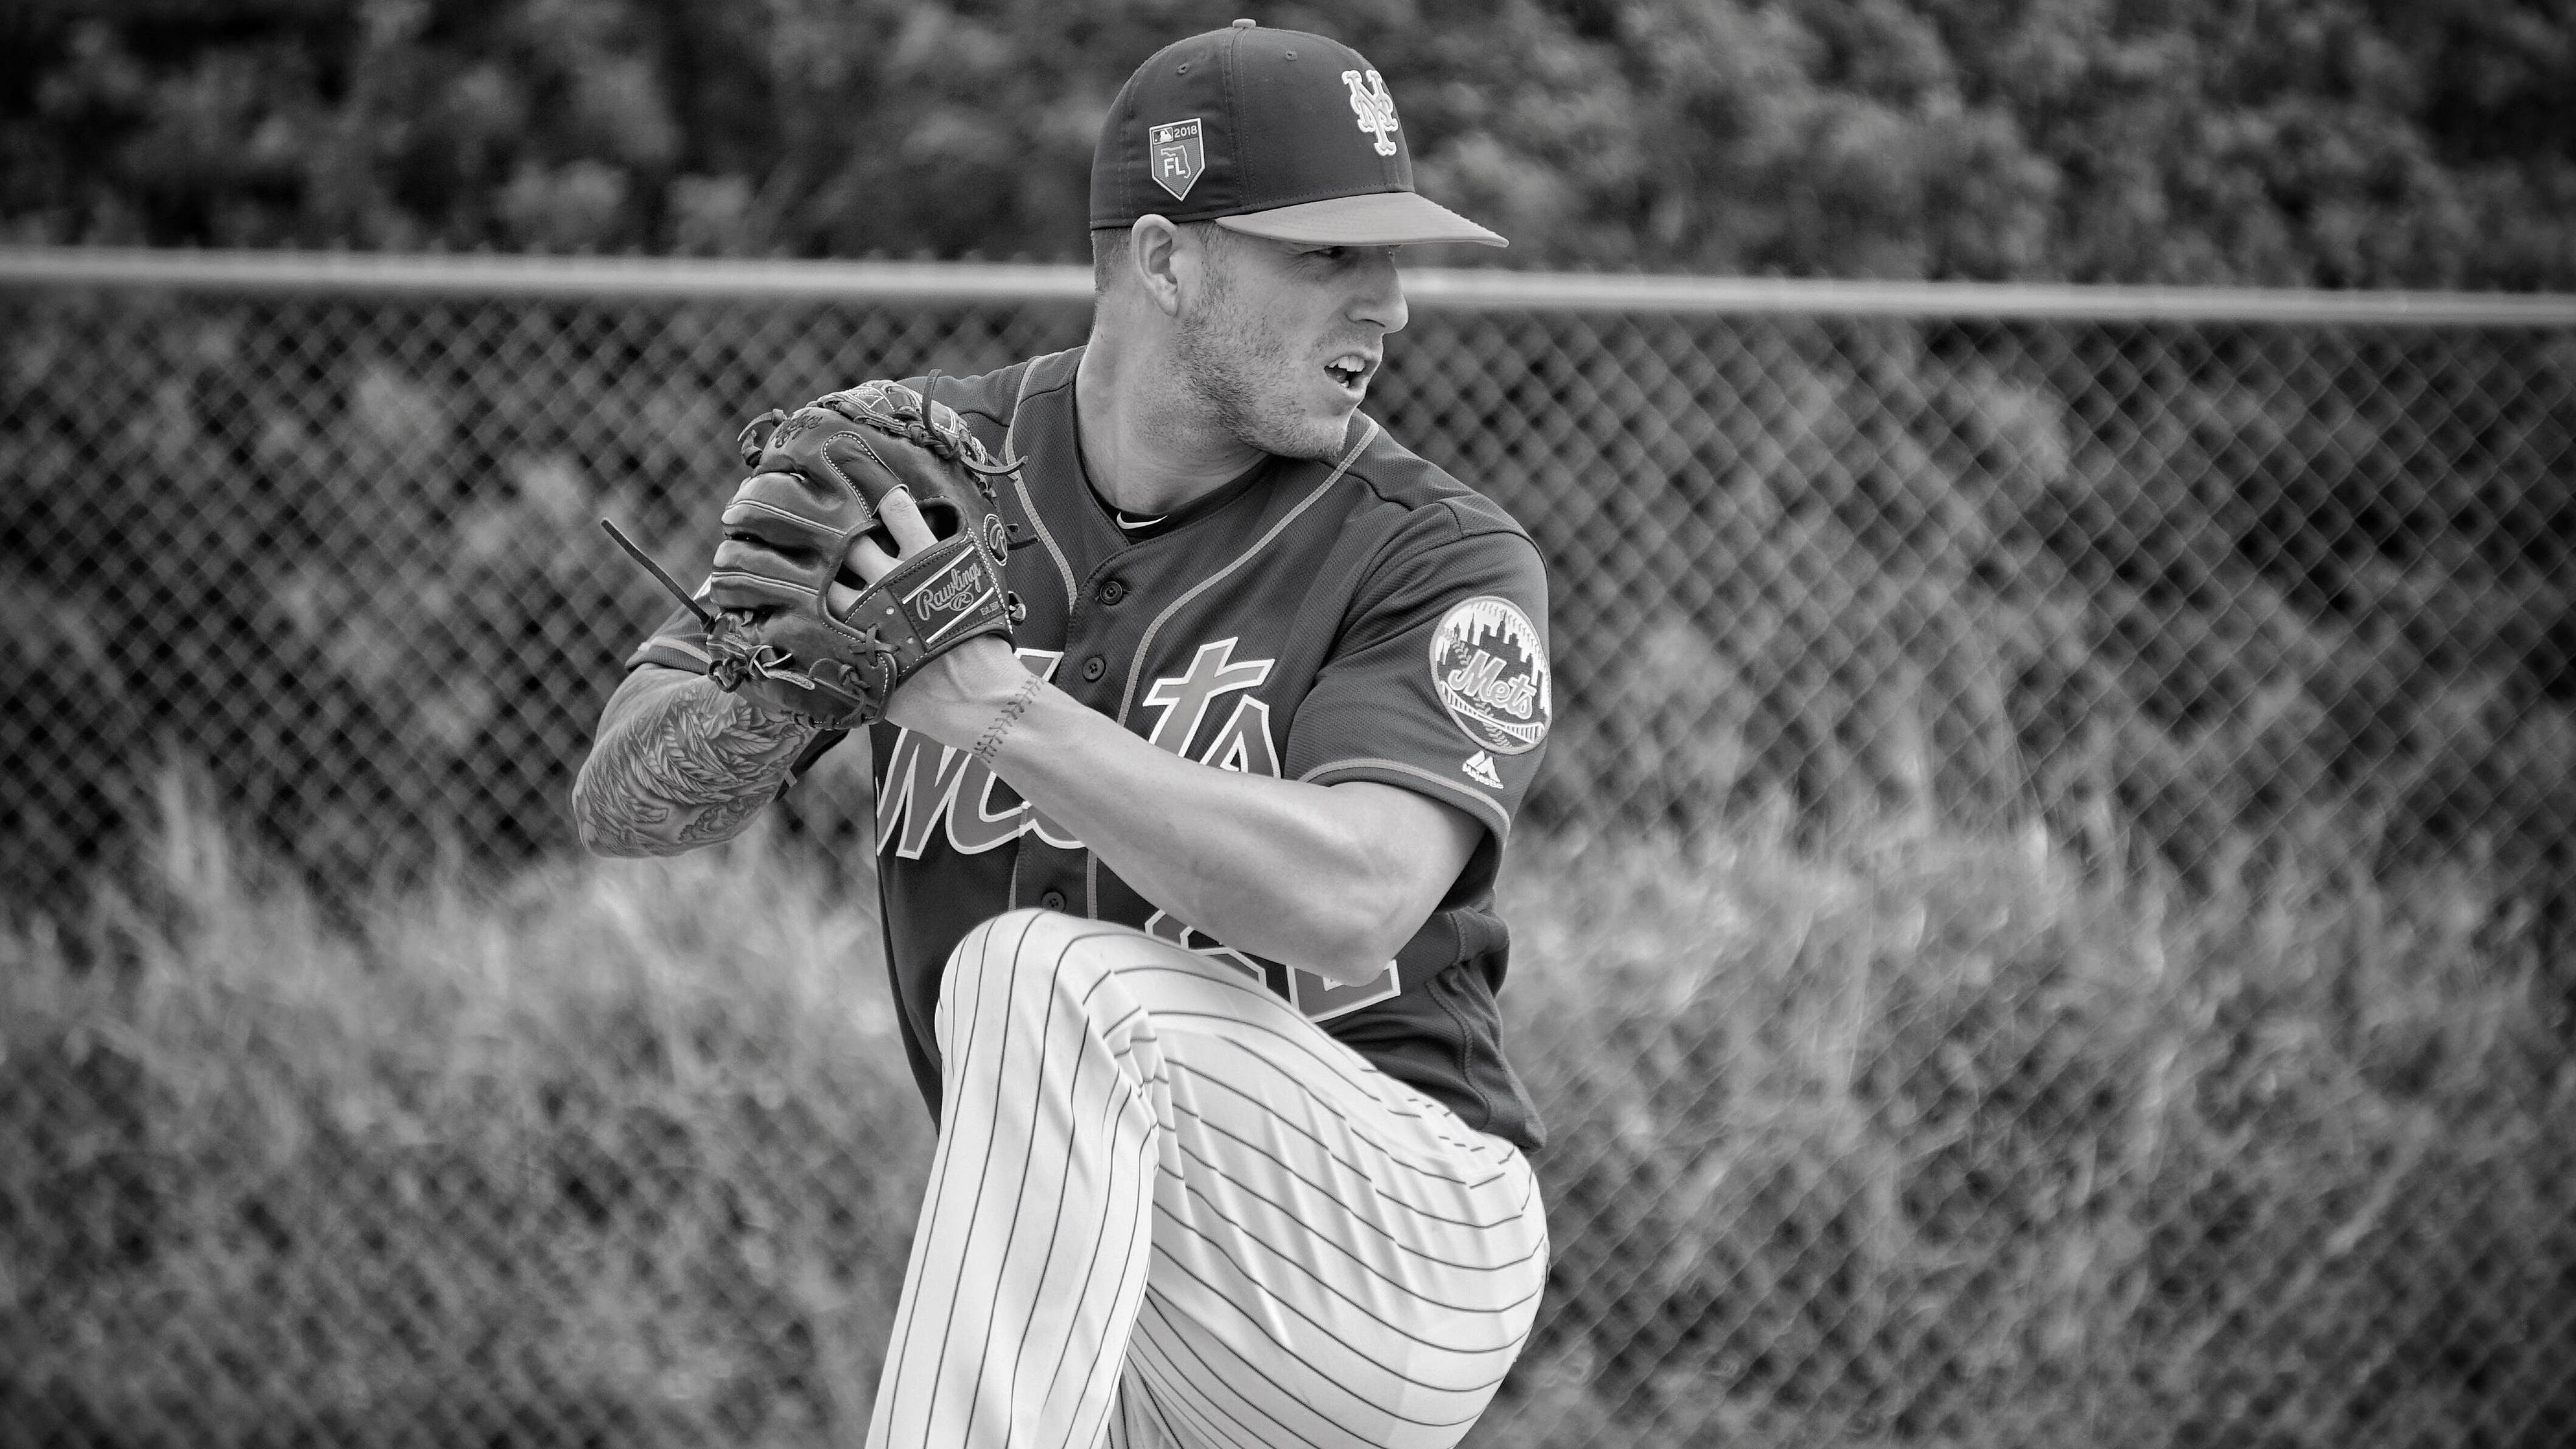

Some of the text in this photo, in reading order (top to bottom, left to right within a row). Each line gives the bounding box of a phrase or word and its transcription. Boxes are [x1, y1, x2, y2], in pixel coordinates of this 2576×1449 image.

[1174, 125, 1197, 138] 2018
[1164, 156, 1186, 177] FL
[1448, 649, 1537, 720] Mets
[876, 637, 1281, 860] Mt
